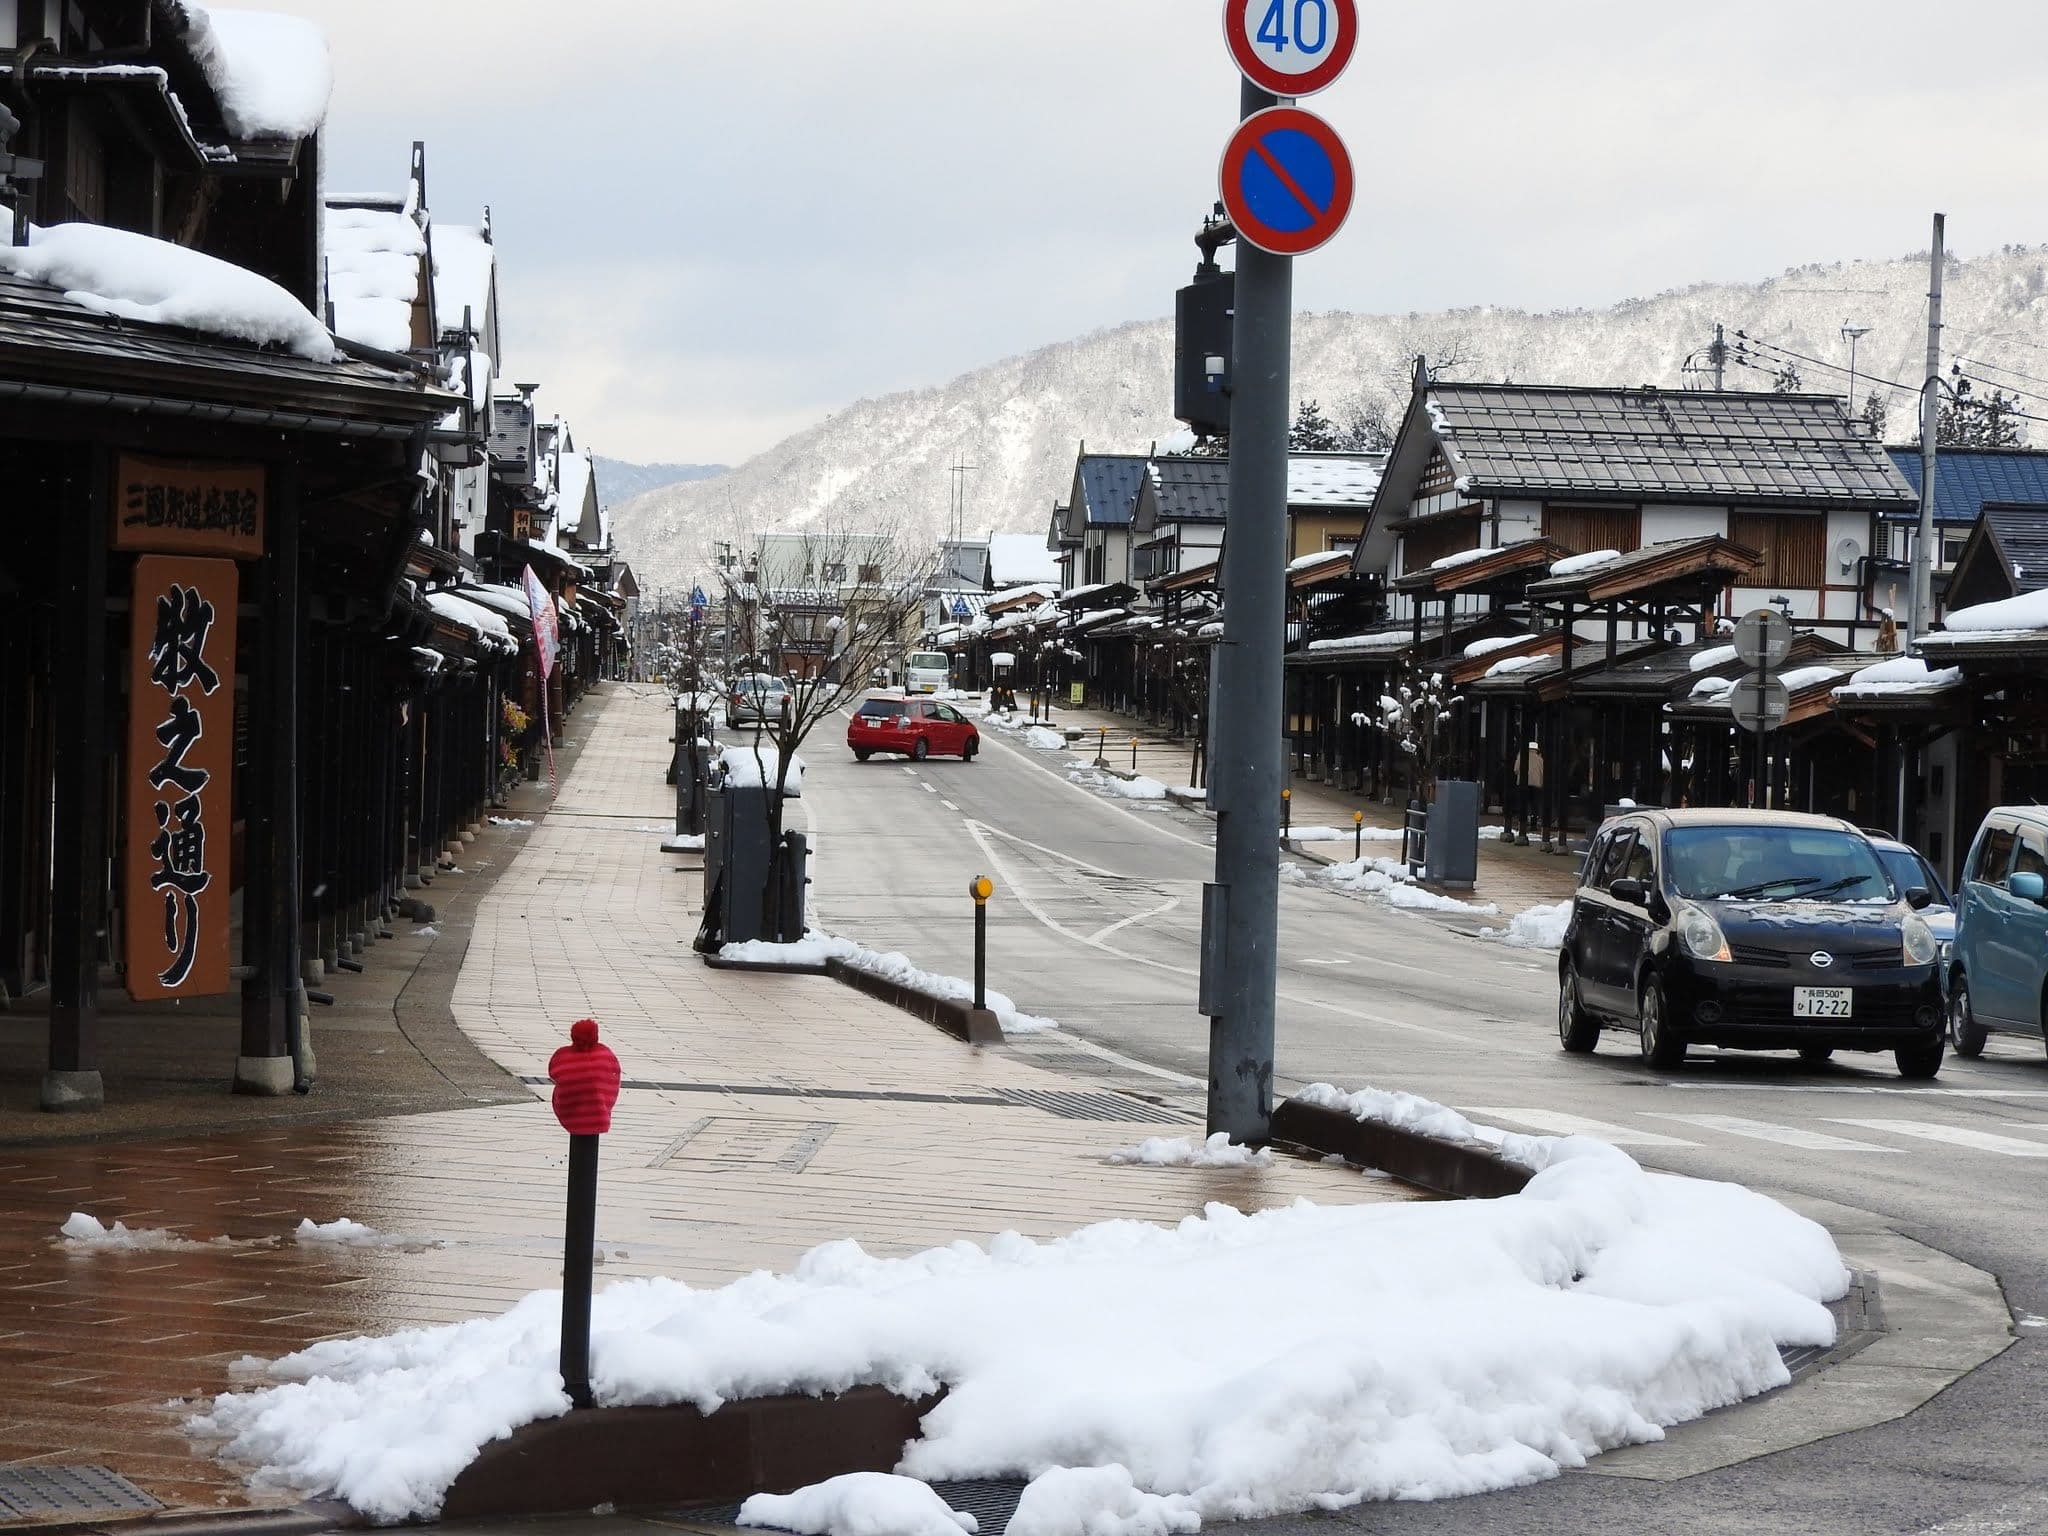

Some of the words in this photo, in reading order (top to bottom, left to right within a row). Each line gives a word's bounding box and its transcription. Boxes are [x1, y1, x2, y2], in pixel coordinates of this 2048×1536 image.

[1257, 0, 1326, 54] 40
[148, 583, 221, 988] 牧之通り
[1808, 999, 1849, 1015] 12-22
